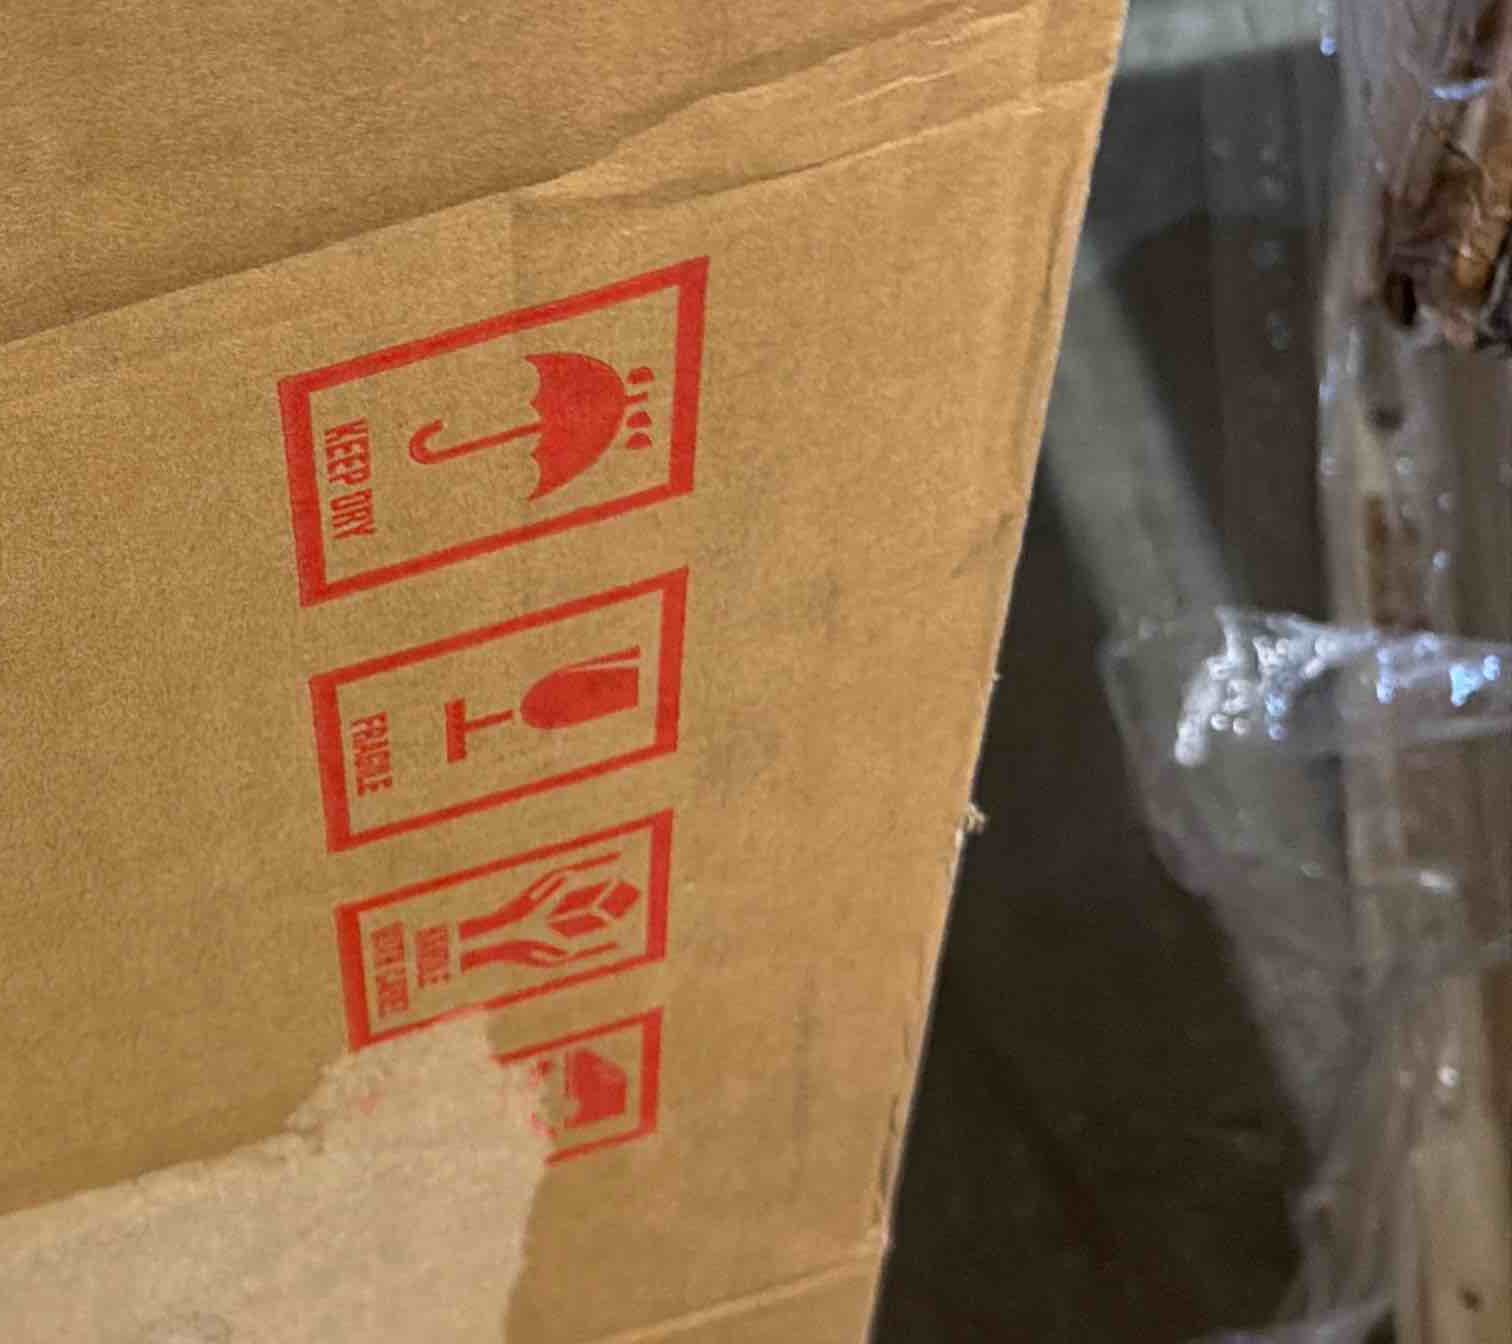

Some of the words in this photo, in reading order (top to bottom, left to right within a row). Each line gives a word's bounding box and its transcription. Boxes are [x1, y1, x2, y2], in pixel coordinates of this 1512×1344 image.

[324, 416, 372, 490] KEEP
[329, 488, 377, 540] DRY
[350, 711, 393, 797] FRAGILE
